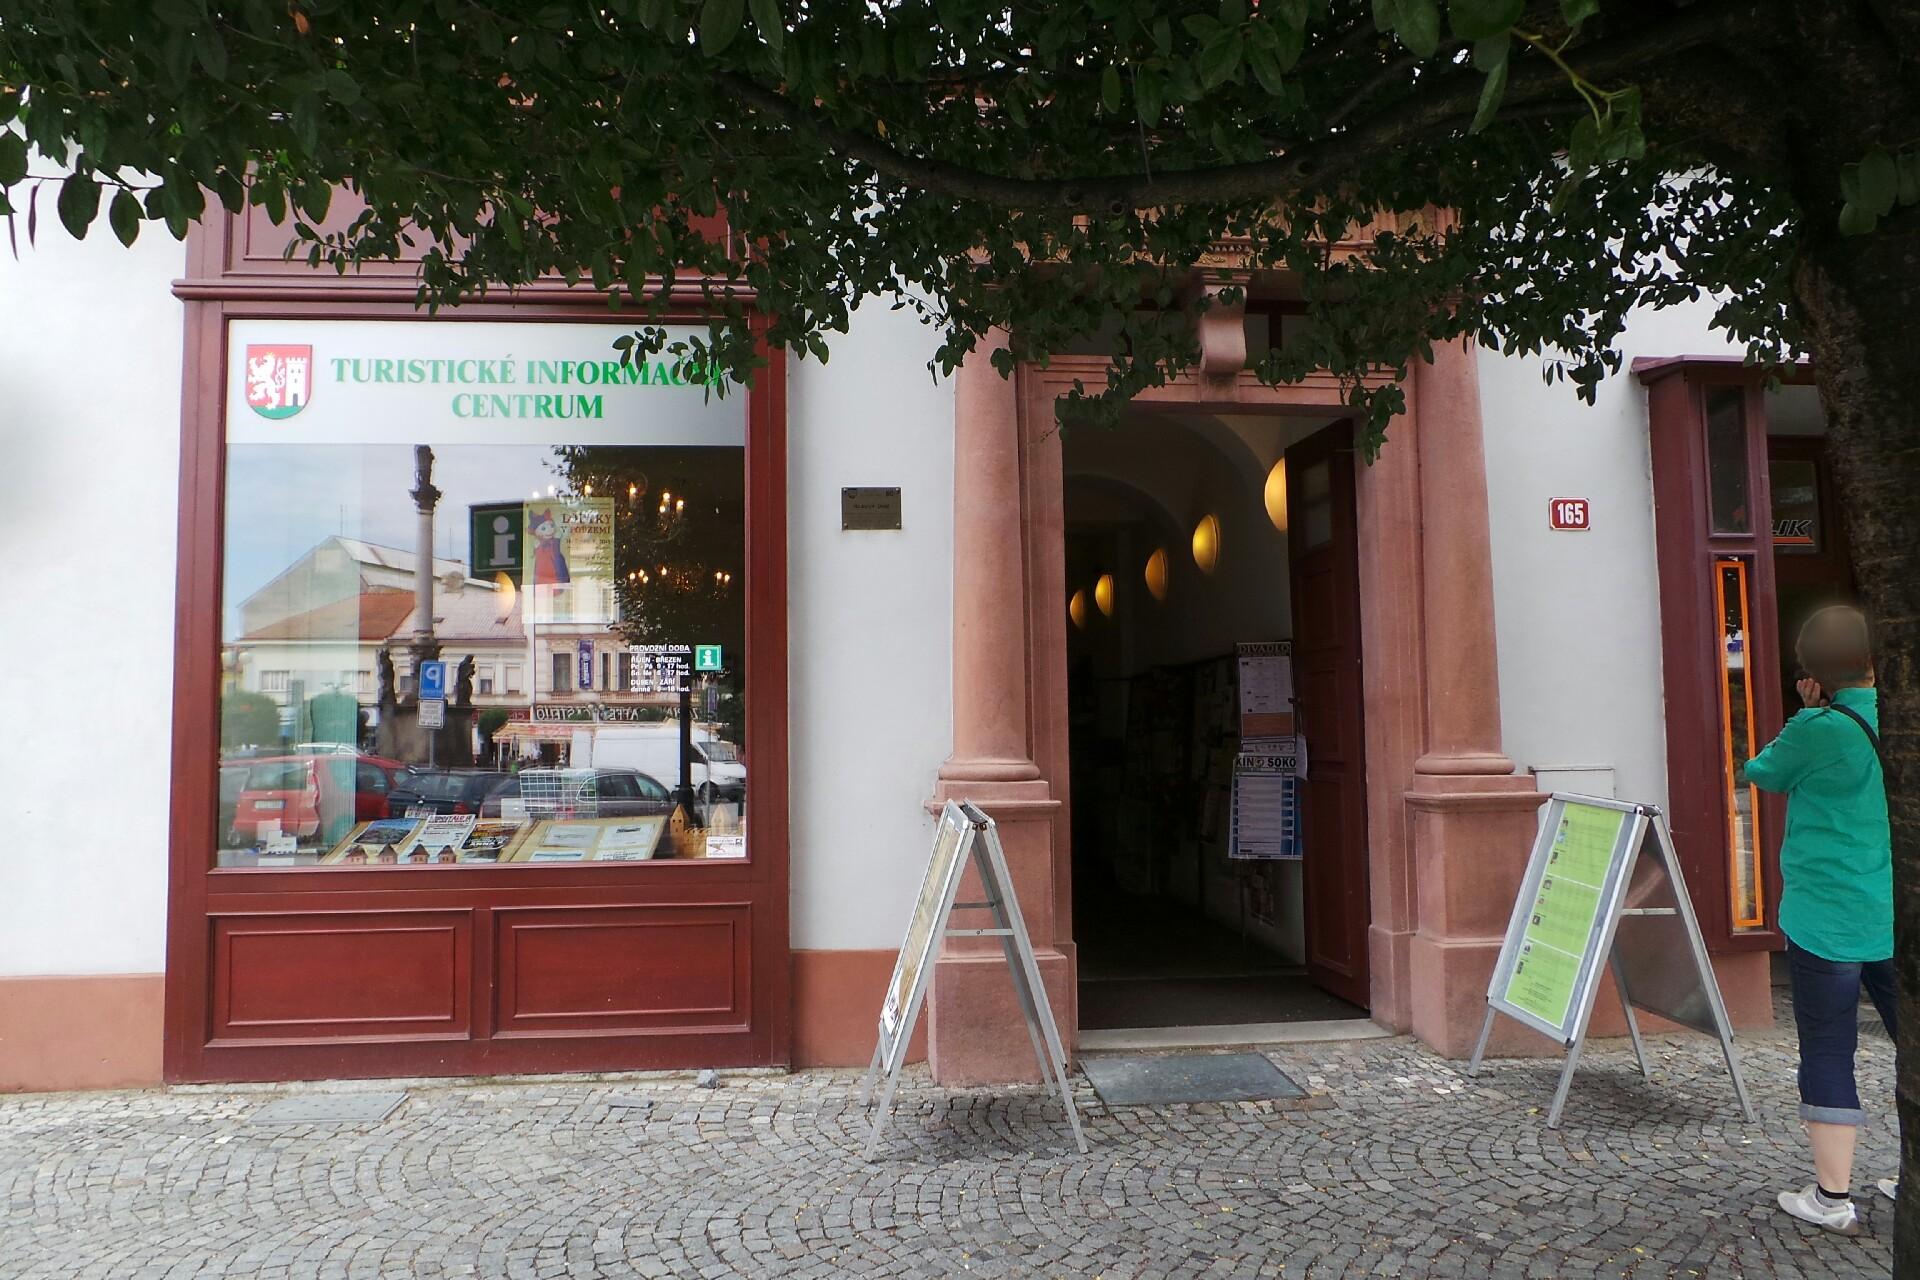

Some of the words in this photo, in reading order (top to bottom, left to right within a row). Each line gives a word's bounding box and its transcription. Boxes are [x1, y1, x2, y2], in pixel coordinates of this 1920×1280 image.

[330, 353, 516, 384] TURISTICKÉ
[527, 353, 722, 387] INFORMAČ
[451, 393, 604, 419] CENTRUM
[1556, 502, 1585, 525] 165
[629, 644, 668, 652] PROVOZNÍ
[668, 644, 690, 652] DOBA
